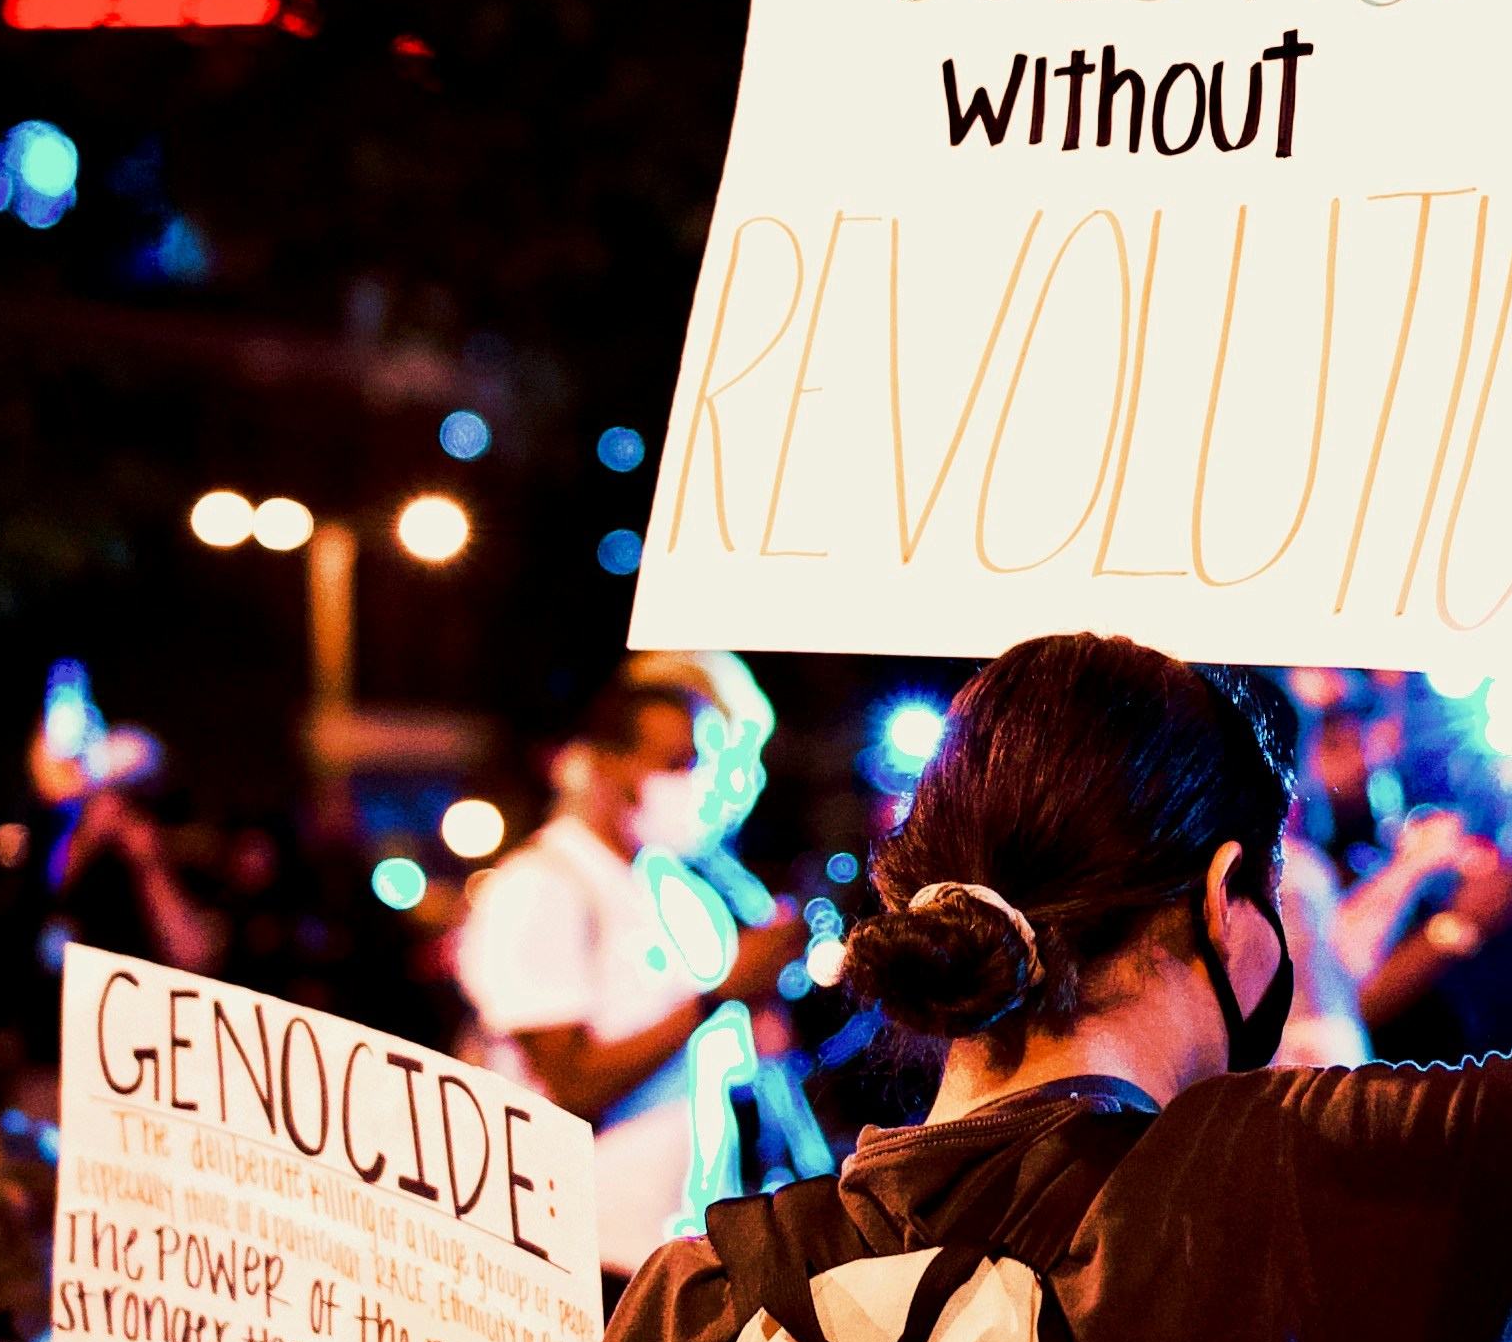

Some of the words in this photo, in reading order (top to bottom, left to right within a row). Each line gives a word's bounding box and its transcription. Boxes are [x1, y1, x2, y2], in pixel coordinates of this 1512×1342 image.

[97, 971, 557, 1259] GENOCIDE:
[111, 1111, 171, 1159] The
[190, 1126, 304, 1202] deliberate
[379, 1207, 397, 1245] of
[405, 1219, 417, 1254] a
[477, 1253, 529, 1312] group
[67, 1210, 144, 1281] The
